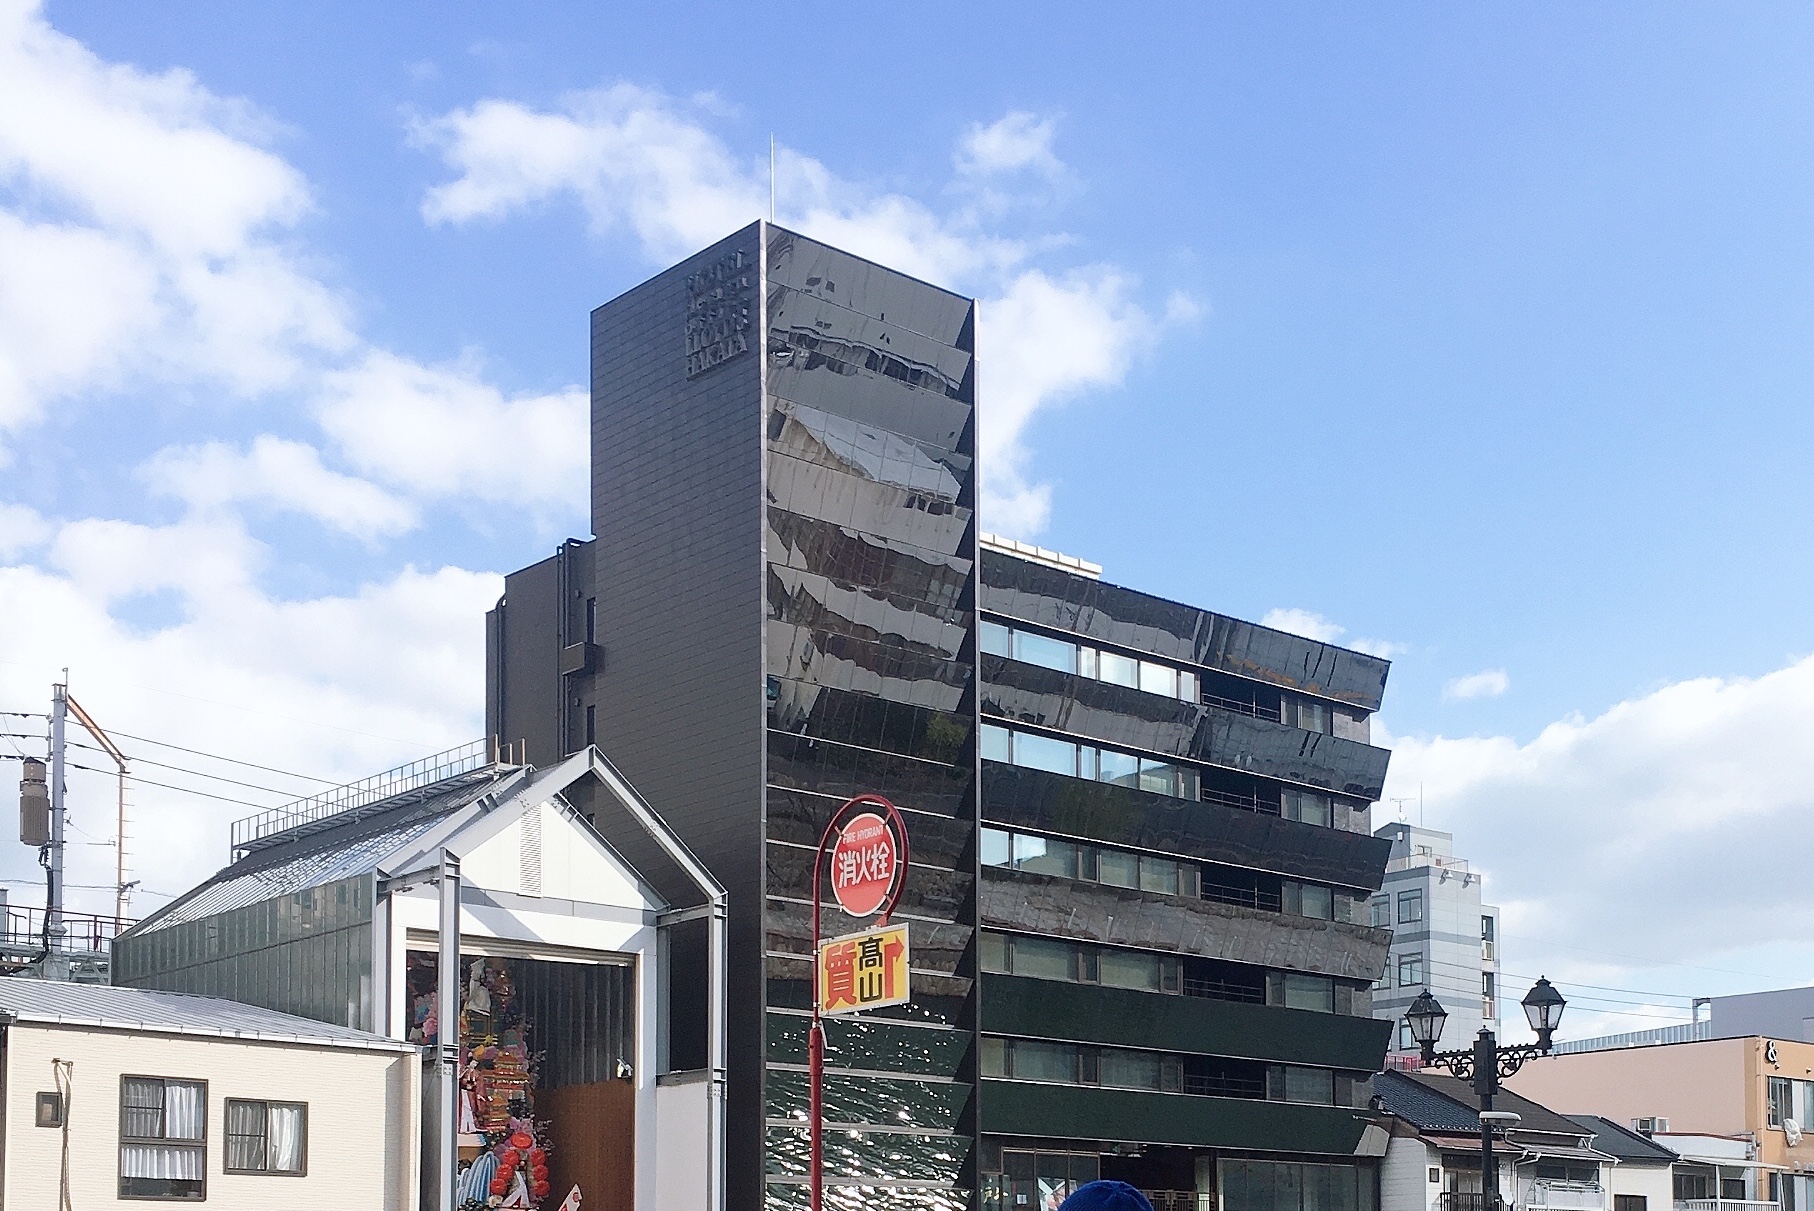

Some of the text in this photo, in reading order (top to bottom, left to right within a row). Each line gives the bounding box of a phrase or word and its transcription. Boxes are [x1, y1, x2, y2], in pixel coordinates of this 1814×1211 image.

[843, 825, 884, 844] FIRE HYDRANT
[838, 841, 890, 888] 消火栓
[825, 941, 857, 1010] 質
